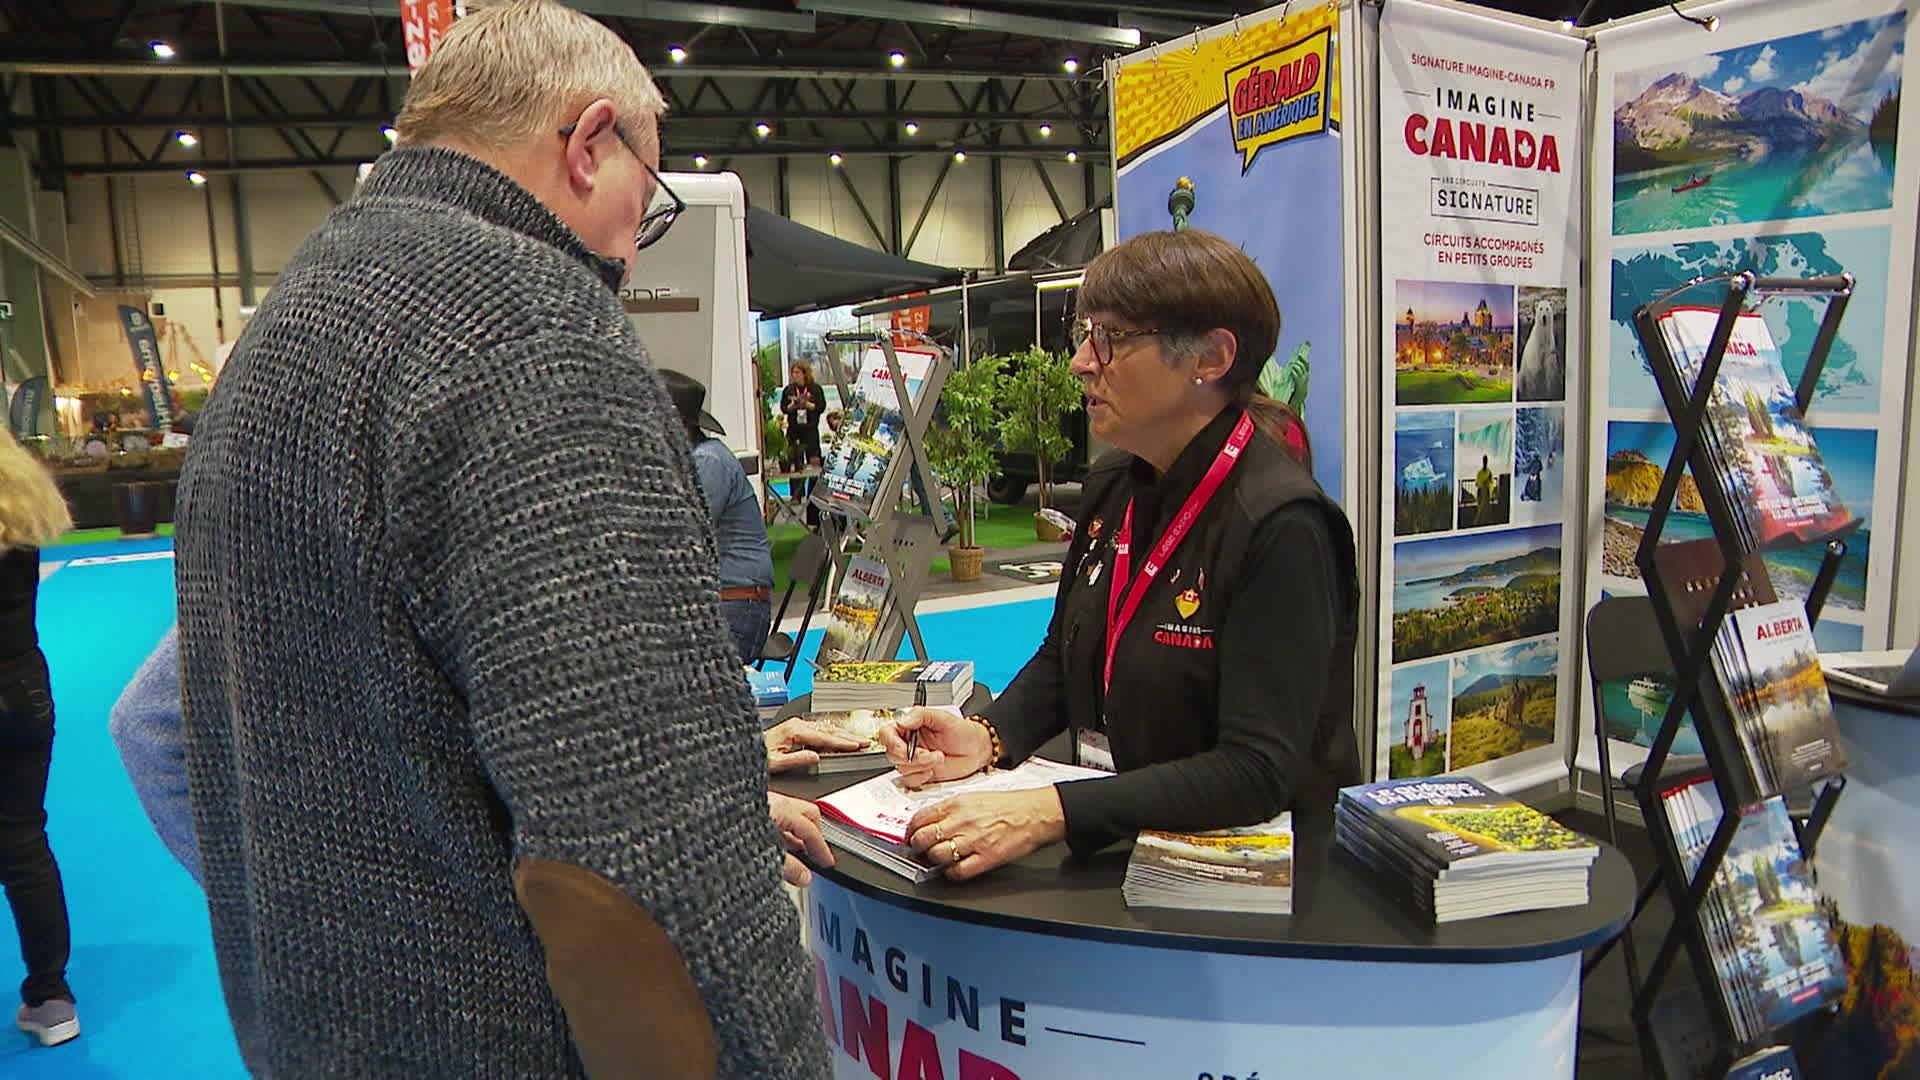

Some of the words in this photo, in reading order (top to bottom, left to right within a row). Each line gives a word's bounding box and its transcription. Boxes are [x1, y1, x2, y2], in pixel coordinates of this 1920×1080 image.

[1233, 52, 1321, 118] GÉRALD
[1237, 115, 1254, 142] EN
[1253, 90, 1321, 138] AMÉRIQUE
[1436, 87, 1535, 122] IMAGINE
[1404, 112, 1561, 173] CANADA
[1437, 189, 1534, 216] SIGNATURE
[1423, 233, 1472, 249] CIRCUITS
[1473, 237, 1545, 255] ACCOMPAGNÉS
[1438, 251, 1453, 264] EN
[1455, 252, 1488, 266] PETITS
[1489, 254, 1533, 269] GROUPES
[1154, 630, 1213, 649] CANADA
[1757, 616, 1804, 641] ALBERTA
